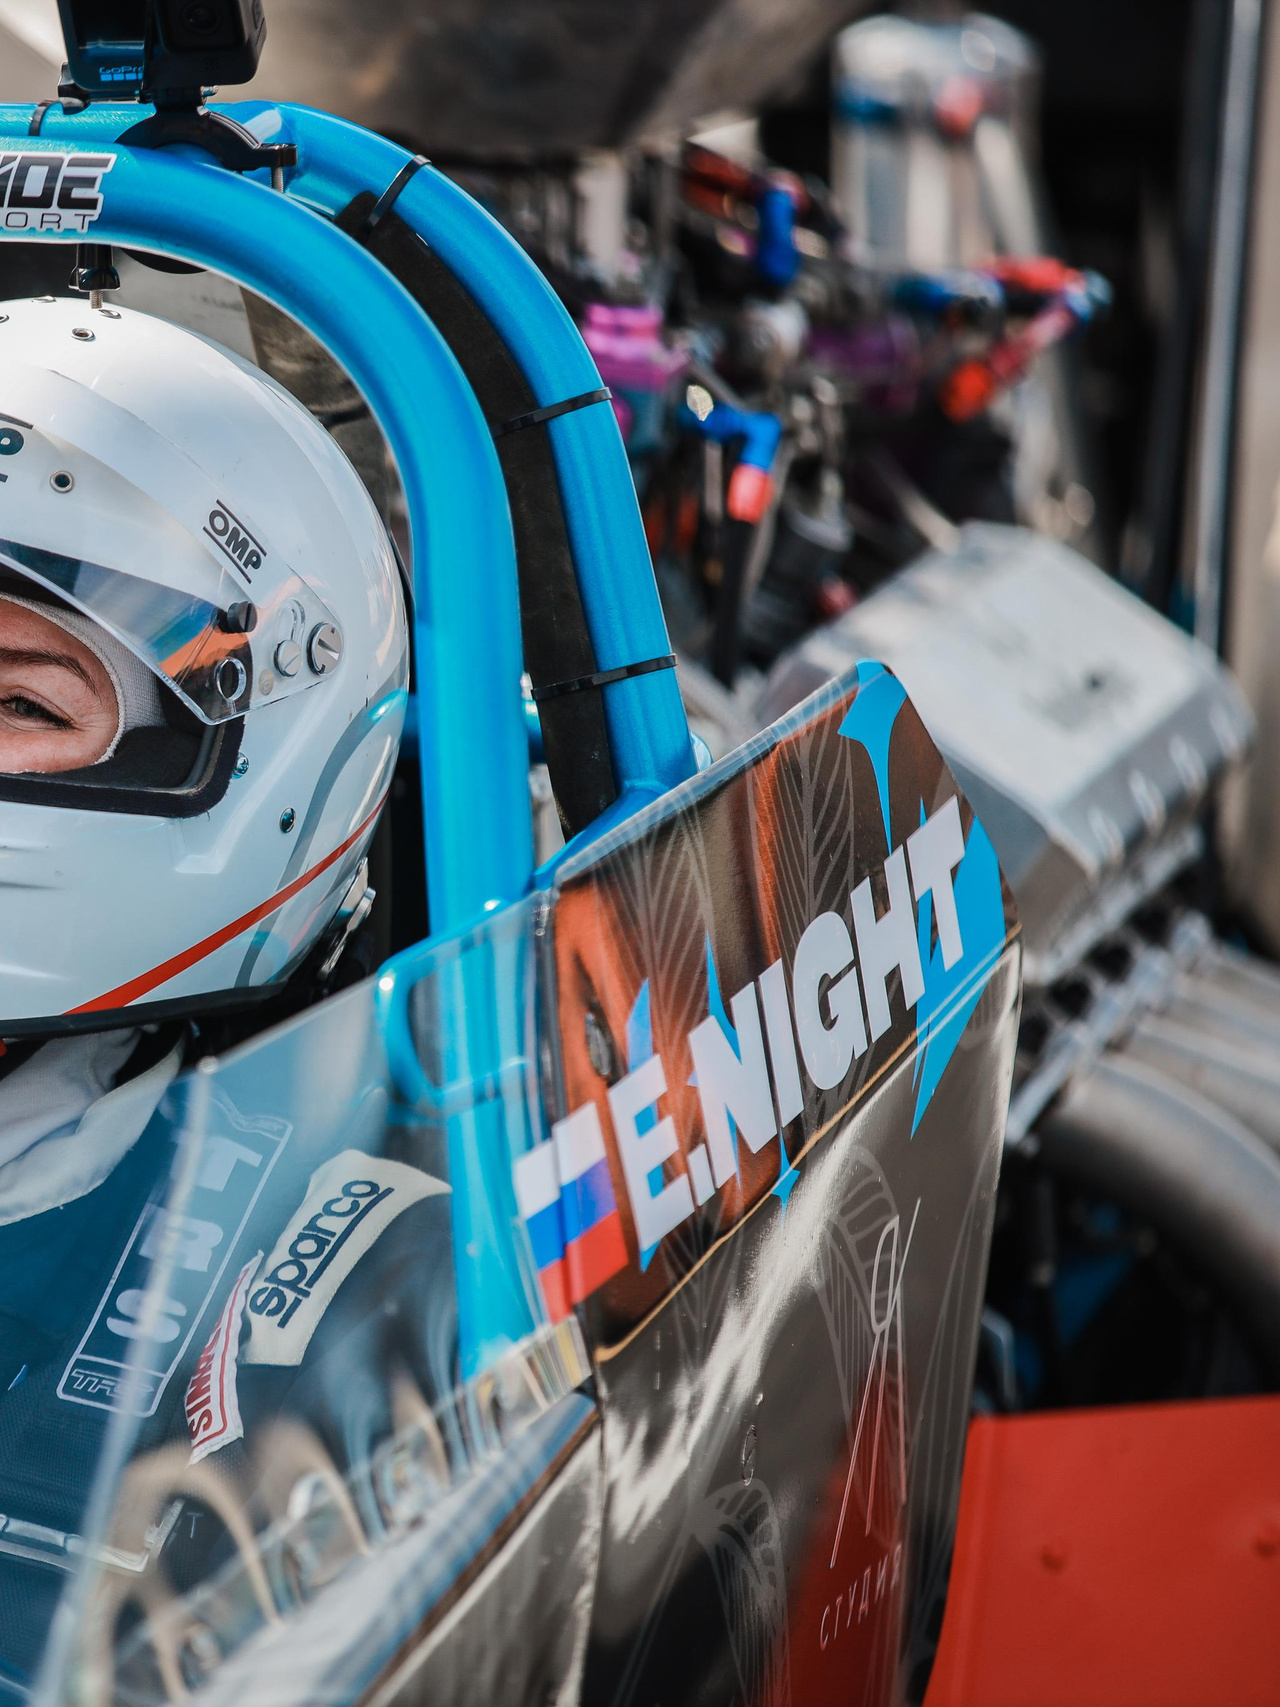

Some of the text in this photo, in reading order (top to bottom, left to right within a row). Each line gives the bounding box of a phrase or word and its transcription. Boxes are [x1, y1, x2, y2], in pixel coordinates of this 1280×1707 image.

[208, 509, 263, 571] OMP
[608, 794, 966, 1250] E.NIGHT
[249, 1178, 381, 1318] sparco
